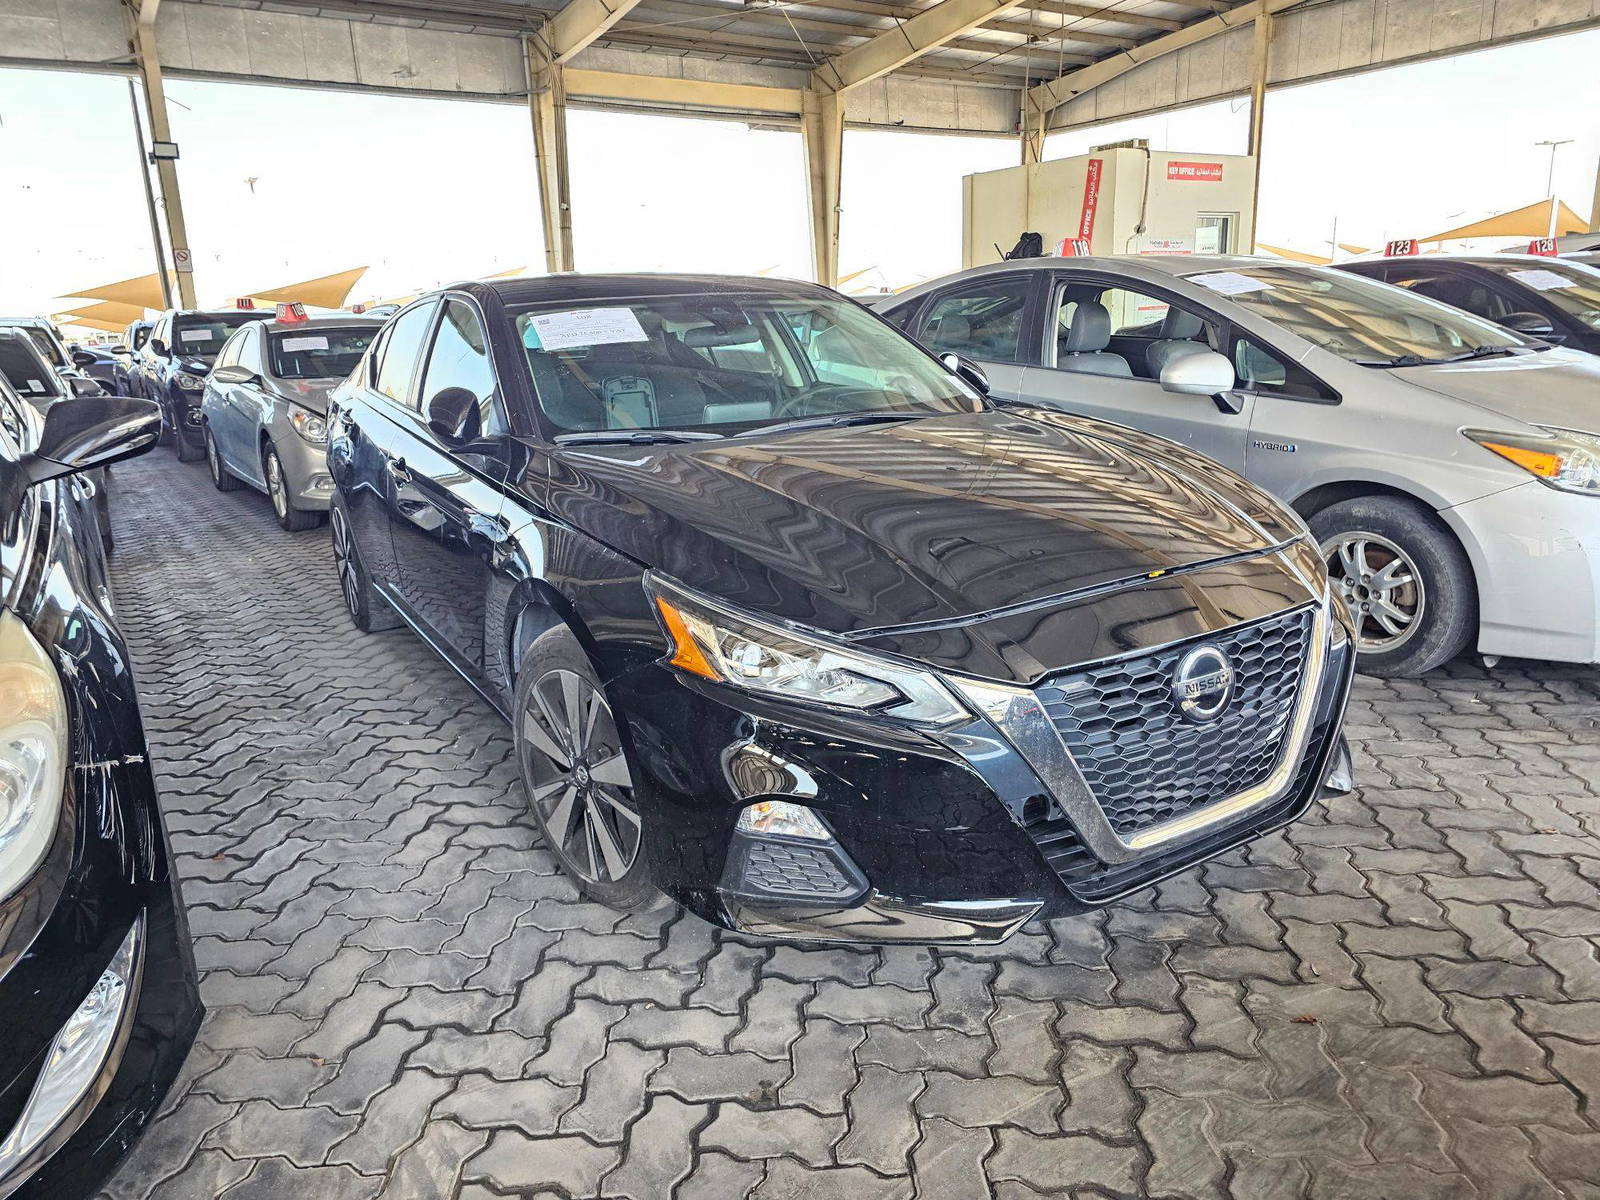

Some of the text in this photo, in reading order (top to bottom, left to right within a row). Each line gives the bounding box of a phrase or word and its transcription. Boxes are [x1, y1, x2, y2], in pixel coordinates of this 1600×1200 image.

[1169, 167, 1195, 176] KEY OFFICE
[1083, 208, 1092, 235] OFFICE
[1073, 239, 1089, 256] 118
[1389, 240, 1411, 255] 123
[1535, 239, 1554, 252] 128
[291, 303, 305, 317] 109
[1253, 440, 1289, 452] HYBRID
[1185, 671, 1229, 694] NISSAN
